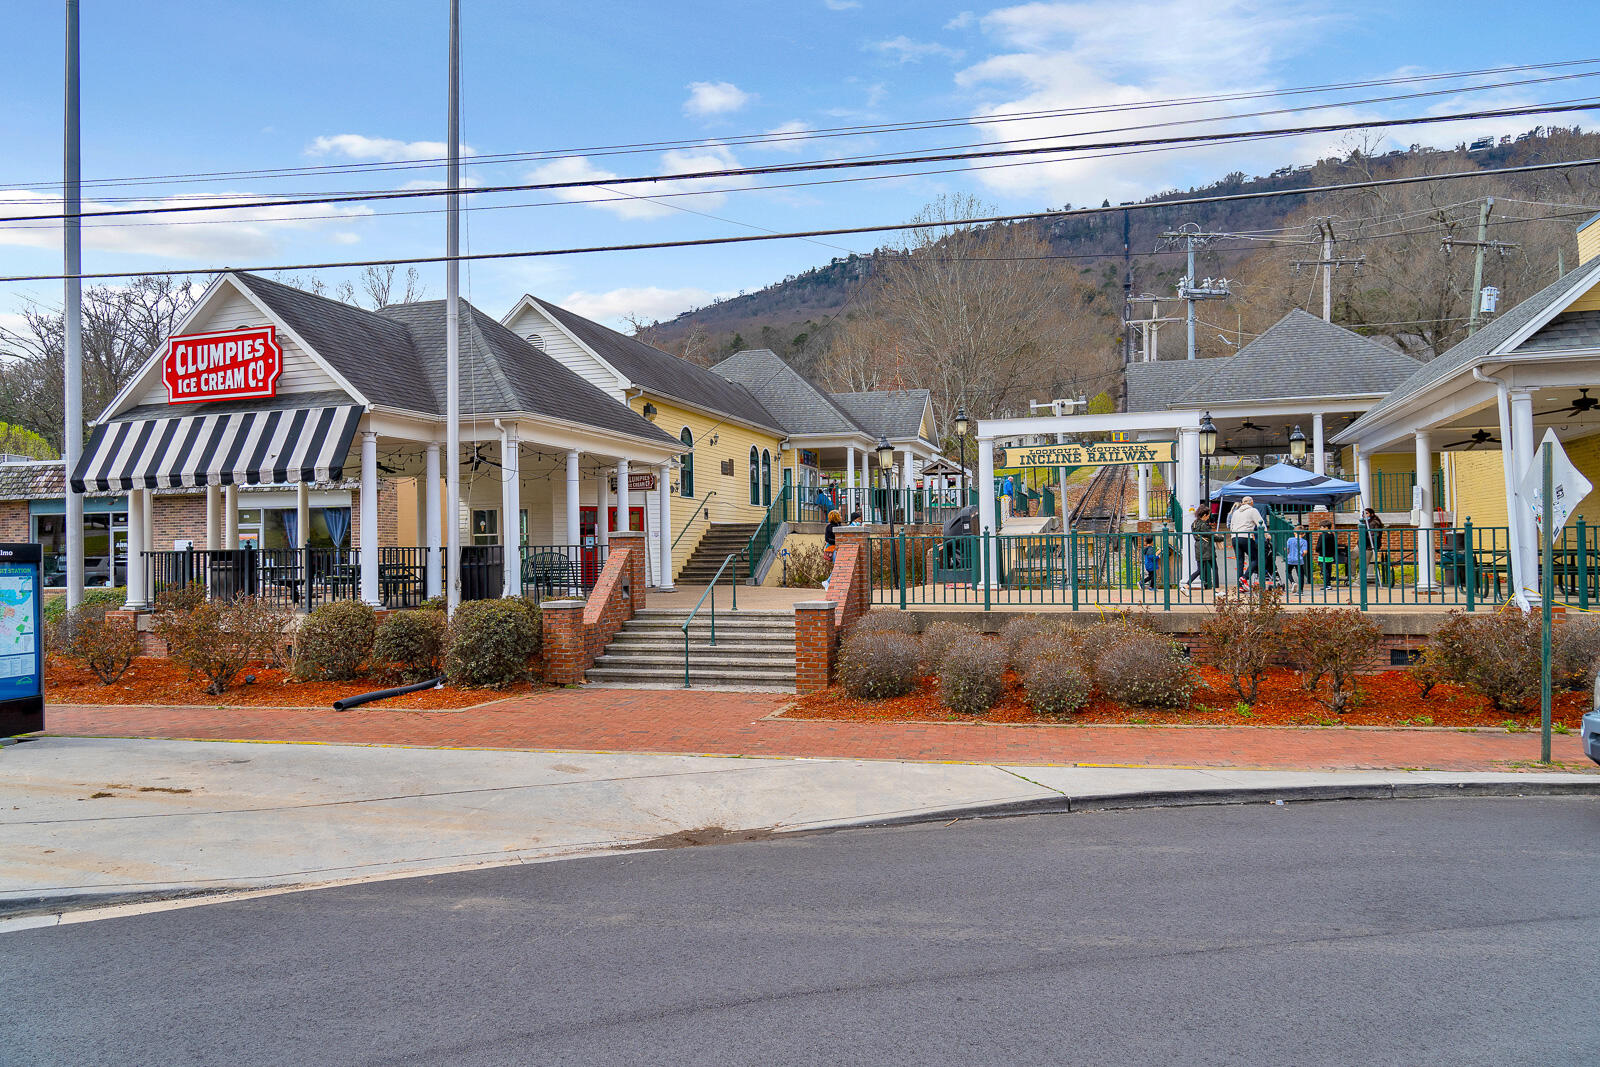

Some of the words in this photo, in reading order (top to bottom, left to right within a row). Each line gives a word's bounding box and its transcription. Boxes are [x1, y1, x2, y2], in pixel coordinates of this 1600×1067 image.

[175, 338, 265, 376] CLUMPIES
[177, 377, 198, 394] ICE
[200, 366, 245, 392] CREAM
[1019, 453, 1082, 465] INCLINE
[1087, 450, 1158, 463] RAILWAY
[1028, 447, 1080, 455] LOOKOUT
[1085, 445, 1148, 453] MOUNTAIN
[628, 475, 650, 483] LUMPIES
